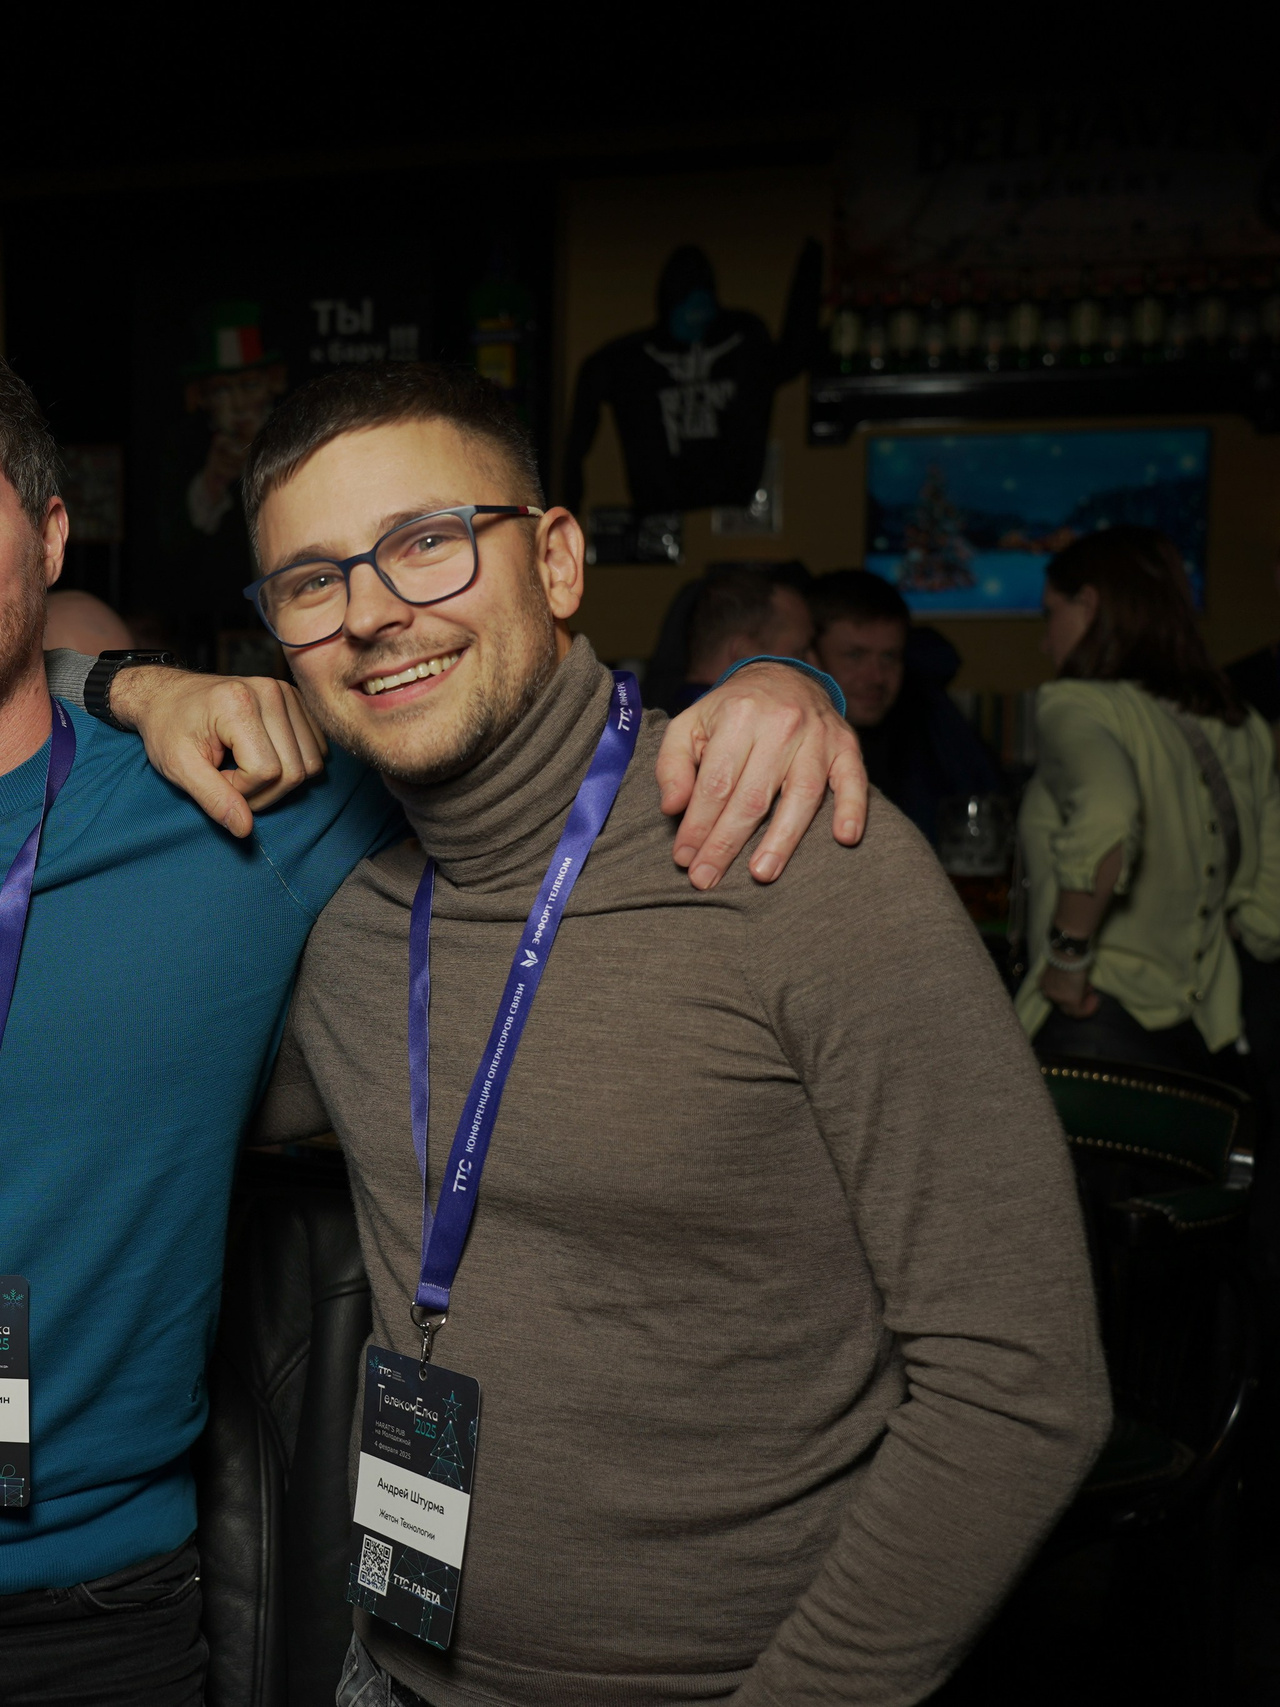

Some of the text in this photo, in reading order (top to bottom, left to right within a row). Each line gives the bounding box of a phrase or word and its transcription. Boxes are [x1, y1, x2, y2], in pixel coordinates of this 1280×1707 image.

[310, 298, 374, 336] ТЫ
[532, 857, 573, 945] ЭФФОРТ ТЕЛЕКОМ
[452, 982, 525, 1193] ТТС КОНФЕРЕНЦИЯ ОПЕРАТОРОВ СВЯЗИ
[395, 1427, 406, 1437] PUB
[414, 1418, 437, 1439] 2025
[378, 1442, 399, 1455] февраля
[399, 1450, 412, 1460] 2025
[377, 1477, 445, 1515] Андрей Штурма
[378, 1508, 435, 1541] Жетон Технологии
